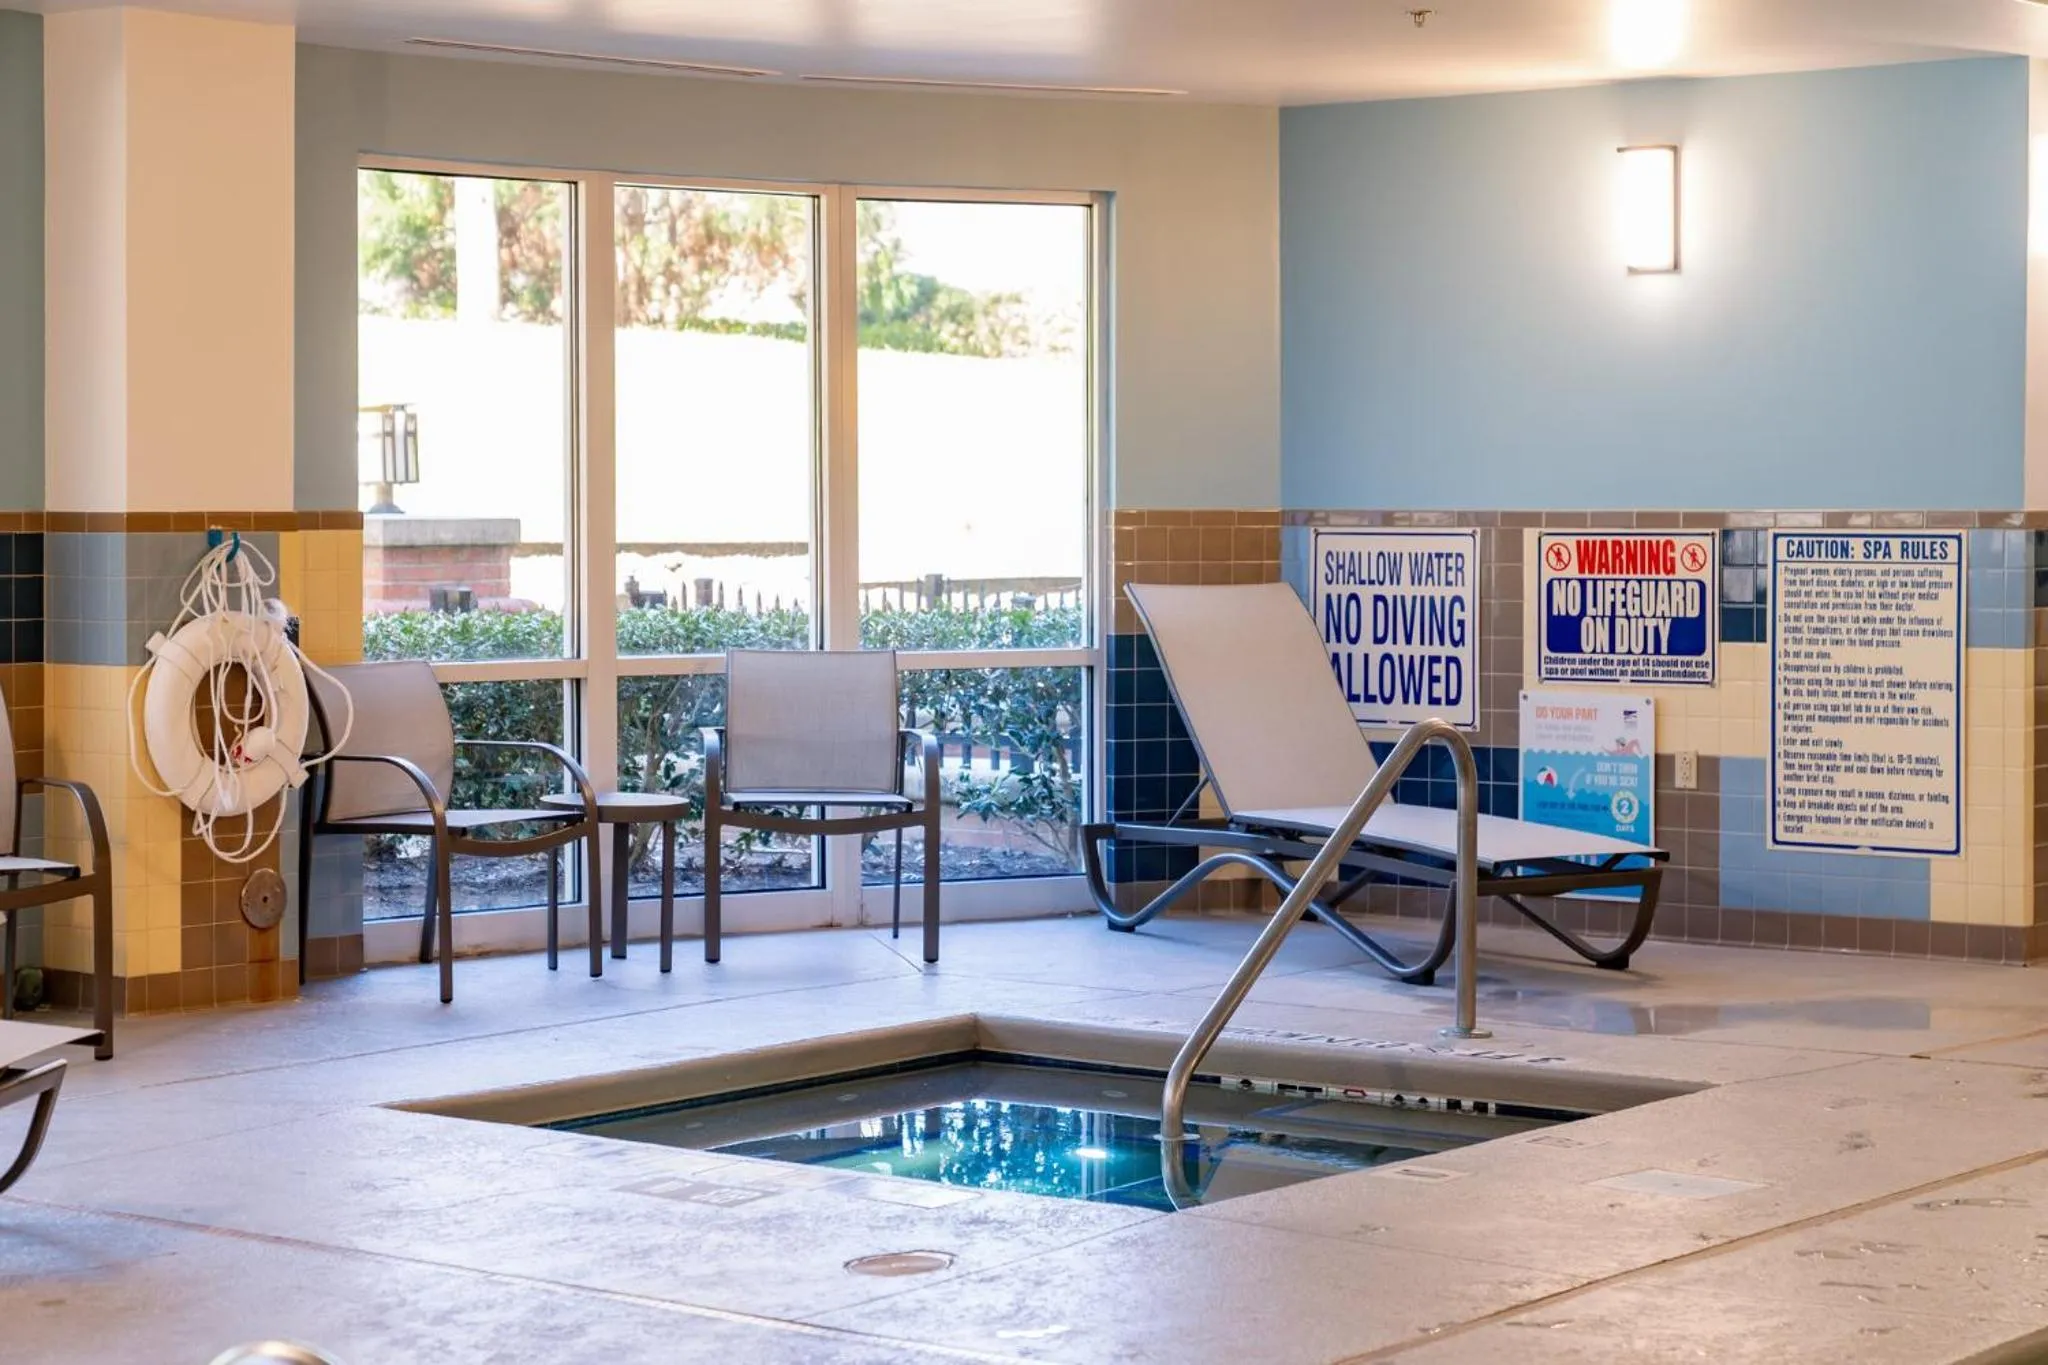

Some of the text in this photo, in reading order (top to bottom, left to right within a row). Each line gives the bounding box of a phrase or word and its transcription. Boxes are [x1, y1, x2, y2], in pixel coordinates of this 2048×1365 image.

[1576, 539, 1677, 576] WARNING
[1787, 539, 1948, 560] CAUTION: SPA RULES
[1325, 550, 1465, 587] SHALLOW WATER
[1552, 579, 1700, 618] NO LIFEGUARD
[1325, 592, 1466, 648] NO DIVING
[1581, 617, 1671, 654] ON DUTY
[1544, 656, 1576, 665] Children
[1578, 657, 1600, 665] under
[1603, 657, 1614, 666] the
[1616, 659, 1630, 668] age
[1632, 658, 1640, 667] of
[1652, 658, 1678, 668] should
[1680, 660, 1693, 668] not
[1695, 660, 1709, 669] use
[1545, 667, 1708, 679] spa or pool without an adult in attendance.
[1535, 706, 1598, 720] DO YOUR PART
[1620, 800, 1629, 813] 2
